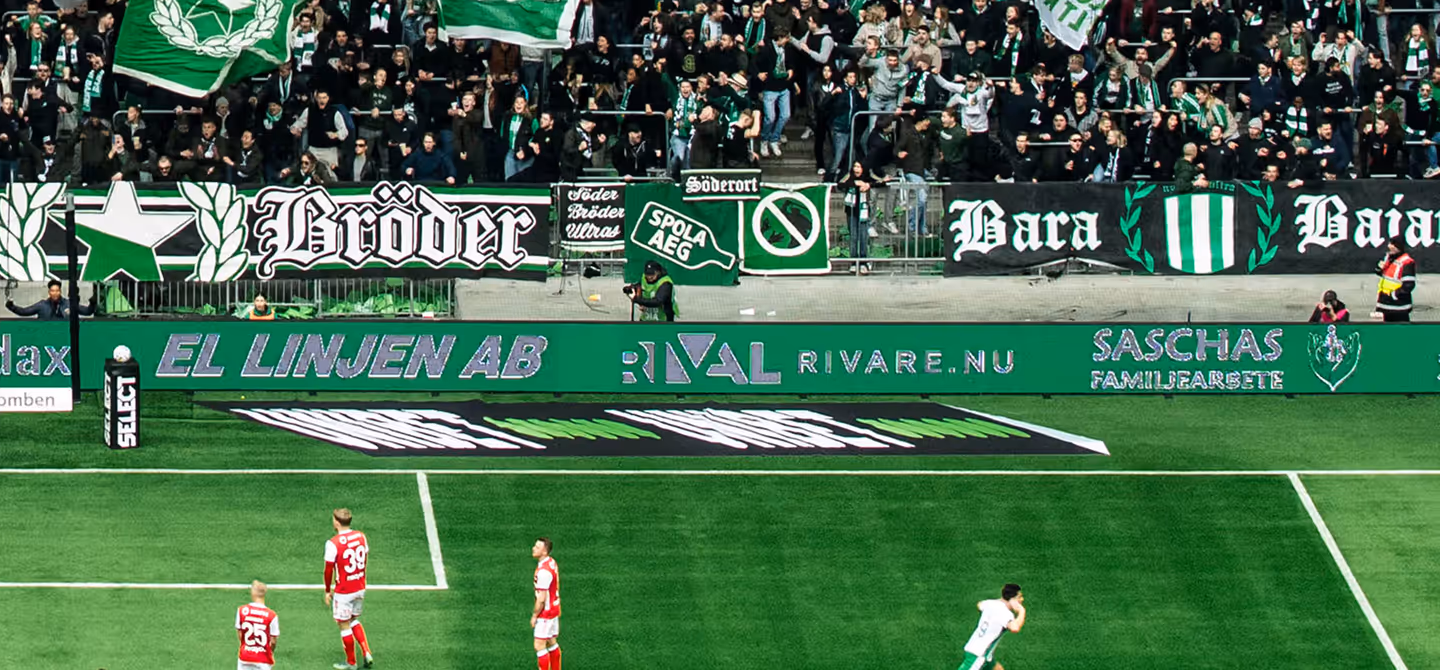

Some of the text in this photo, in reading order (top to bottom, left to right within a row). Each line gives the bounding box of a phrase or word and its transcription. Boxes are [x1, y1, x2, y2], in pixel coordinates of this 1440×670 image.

[567, 187, 619, 201] Söder
[685, 176, 758, 193] Söderort
[567, 203, 625, 219] Bröder
[256, 181, 537, 279] Bröder
[565, 222, 621, 239] Ultras
[648, 209, 707, 248] SPOLA
[949, 198, 1102, 262] Bara
[648, 234, 694, 262] AEG
[155, 333, 548, 379] EL LINJEN AB
[1092, 328, 1283, 362] SASCHAS
[797, 350, 1015, 374] RIVARE.NU
[1091, 370, 1283, 390] FAMILJEARBETE
[117, 375, 137, 448] SELECT
[343, 545, 365, 573] 39
[242, 622, 267, 647] 25
